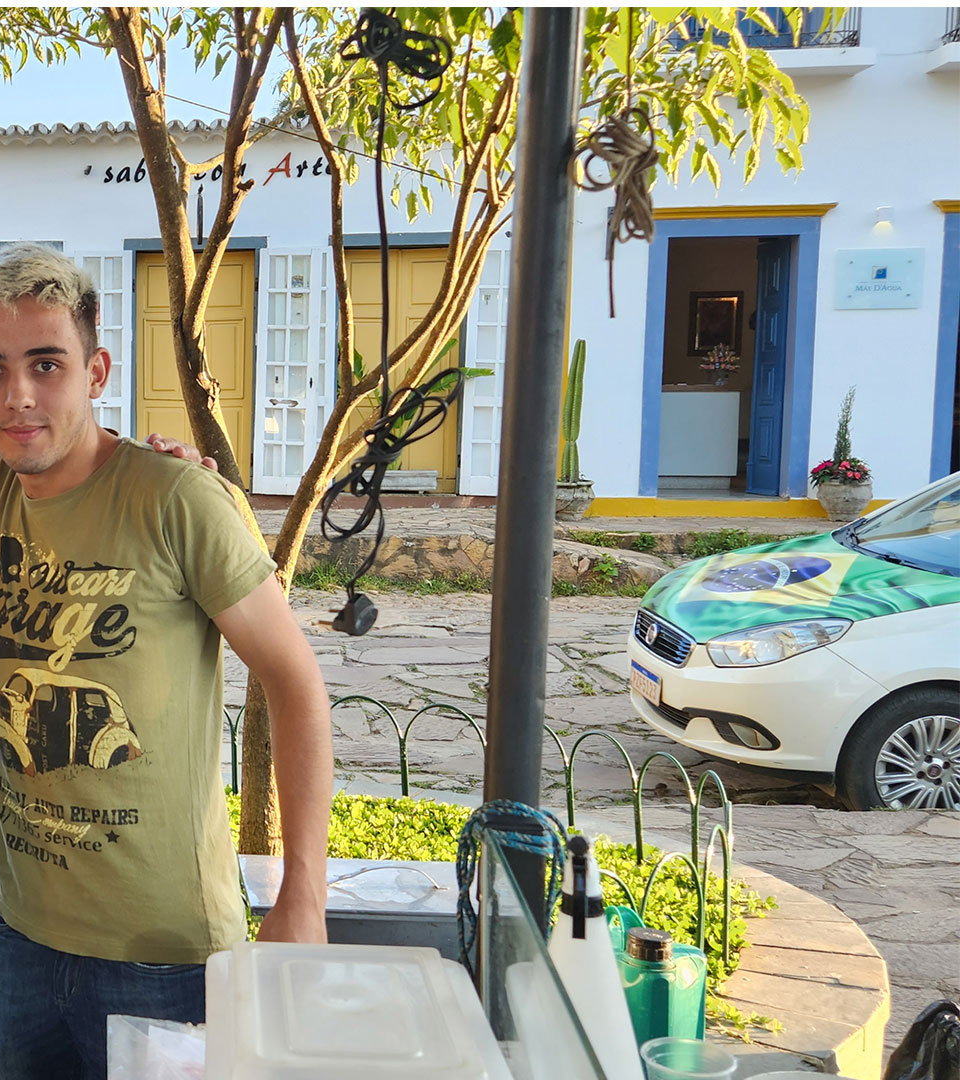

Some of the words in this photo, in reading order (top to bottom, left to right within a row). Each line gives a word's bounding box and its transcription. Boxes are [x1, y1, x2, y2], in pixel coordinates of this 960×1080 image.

[34, 797, 64, 819] AUTO
[70, 805, 139, 826] REPAIRS
[44, 830, 103, 853] service
